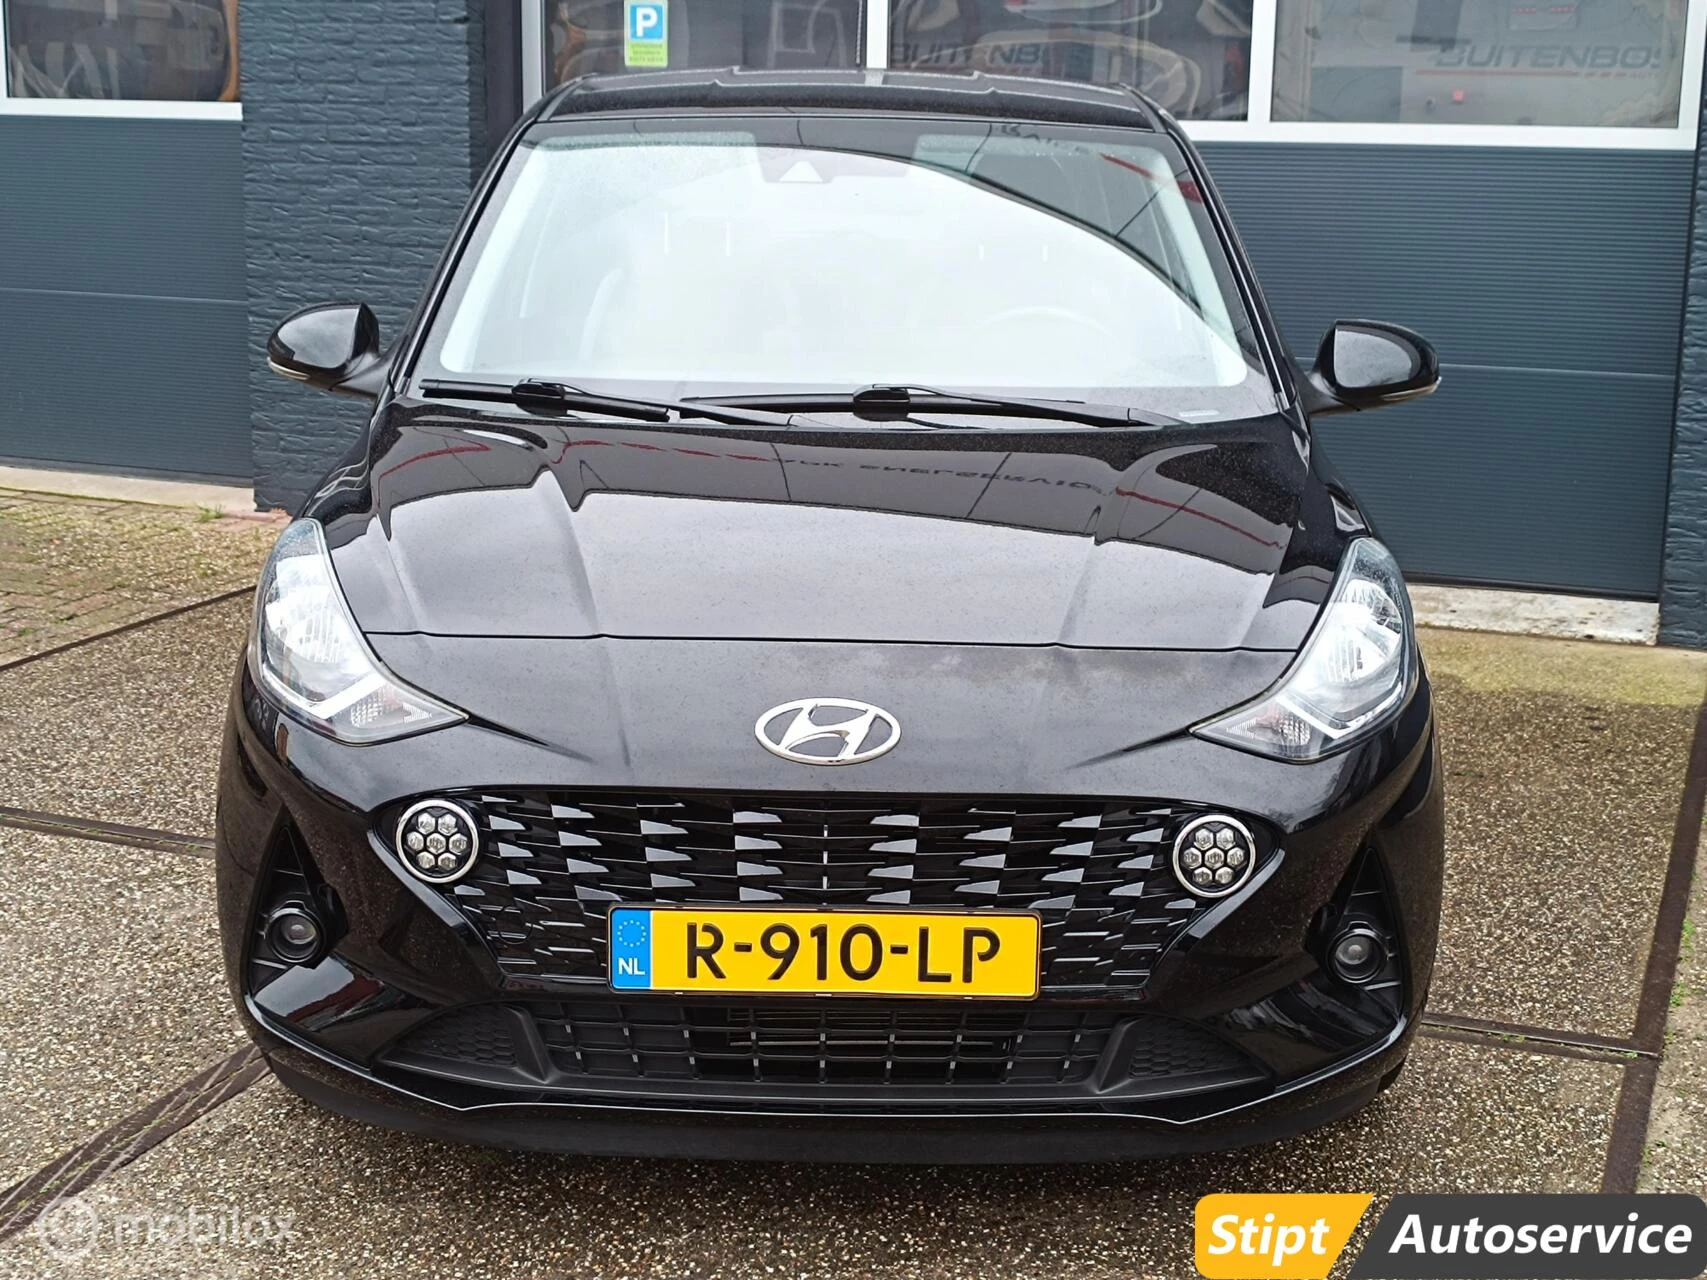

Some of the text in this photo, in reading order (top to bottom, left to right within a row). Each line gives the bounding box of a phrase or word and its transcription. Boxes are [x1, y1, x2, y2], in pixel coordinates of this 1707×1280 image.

[635, 5, 659, 38] P
[617, 922, 1002, 984] NL R-910-LP
